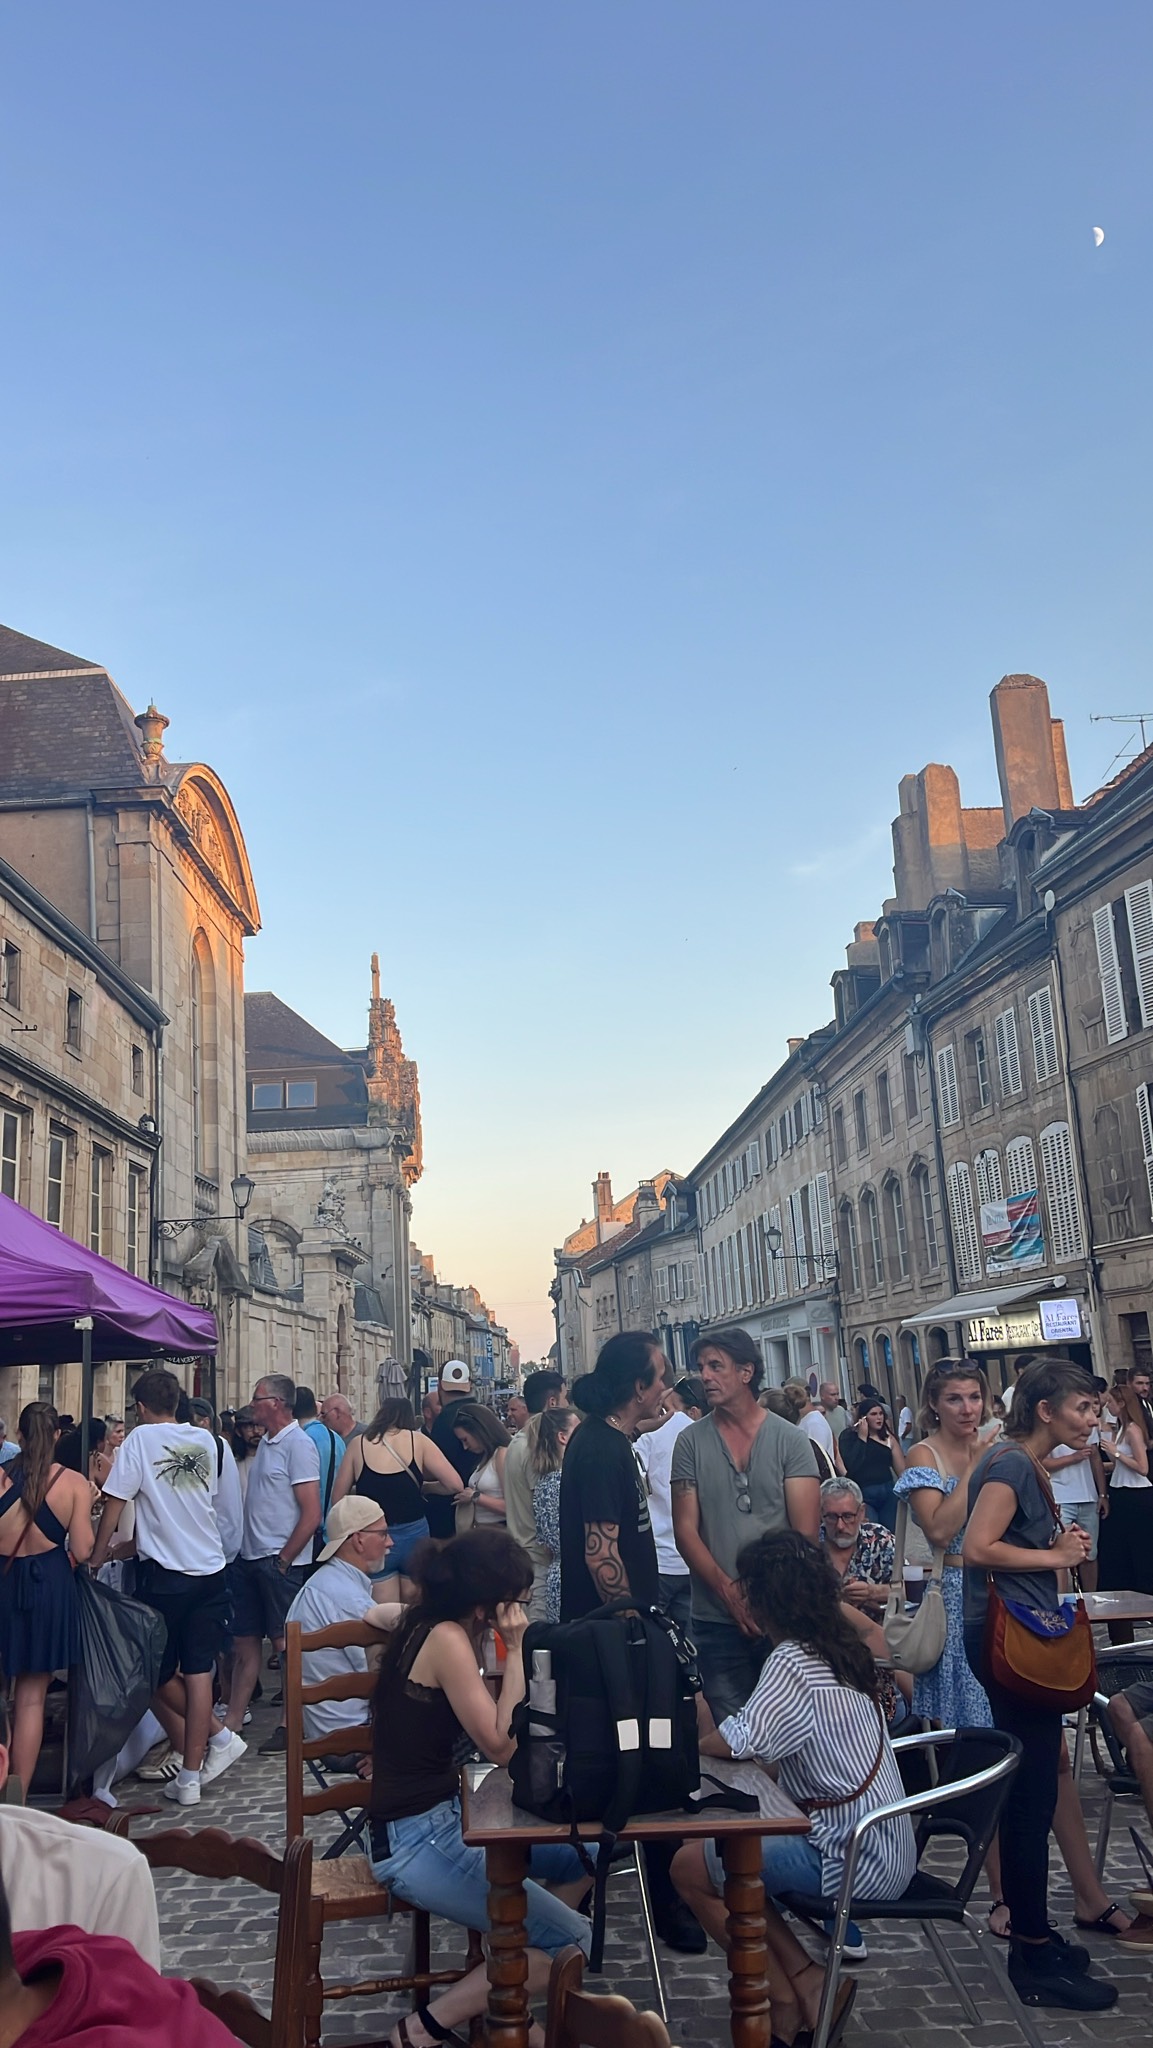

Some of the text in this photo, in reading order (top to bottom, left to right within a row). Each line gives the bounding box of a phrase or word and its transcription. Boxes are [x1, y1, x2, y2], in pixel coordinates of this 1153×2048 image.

[1045, 1312, 1077, 1322] Al Fares
[967, 1320, 978, 1342] Al
[978, 1320, 1004, 1342] Fares
